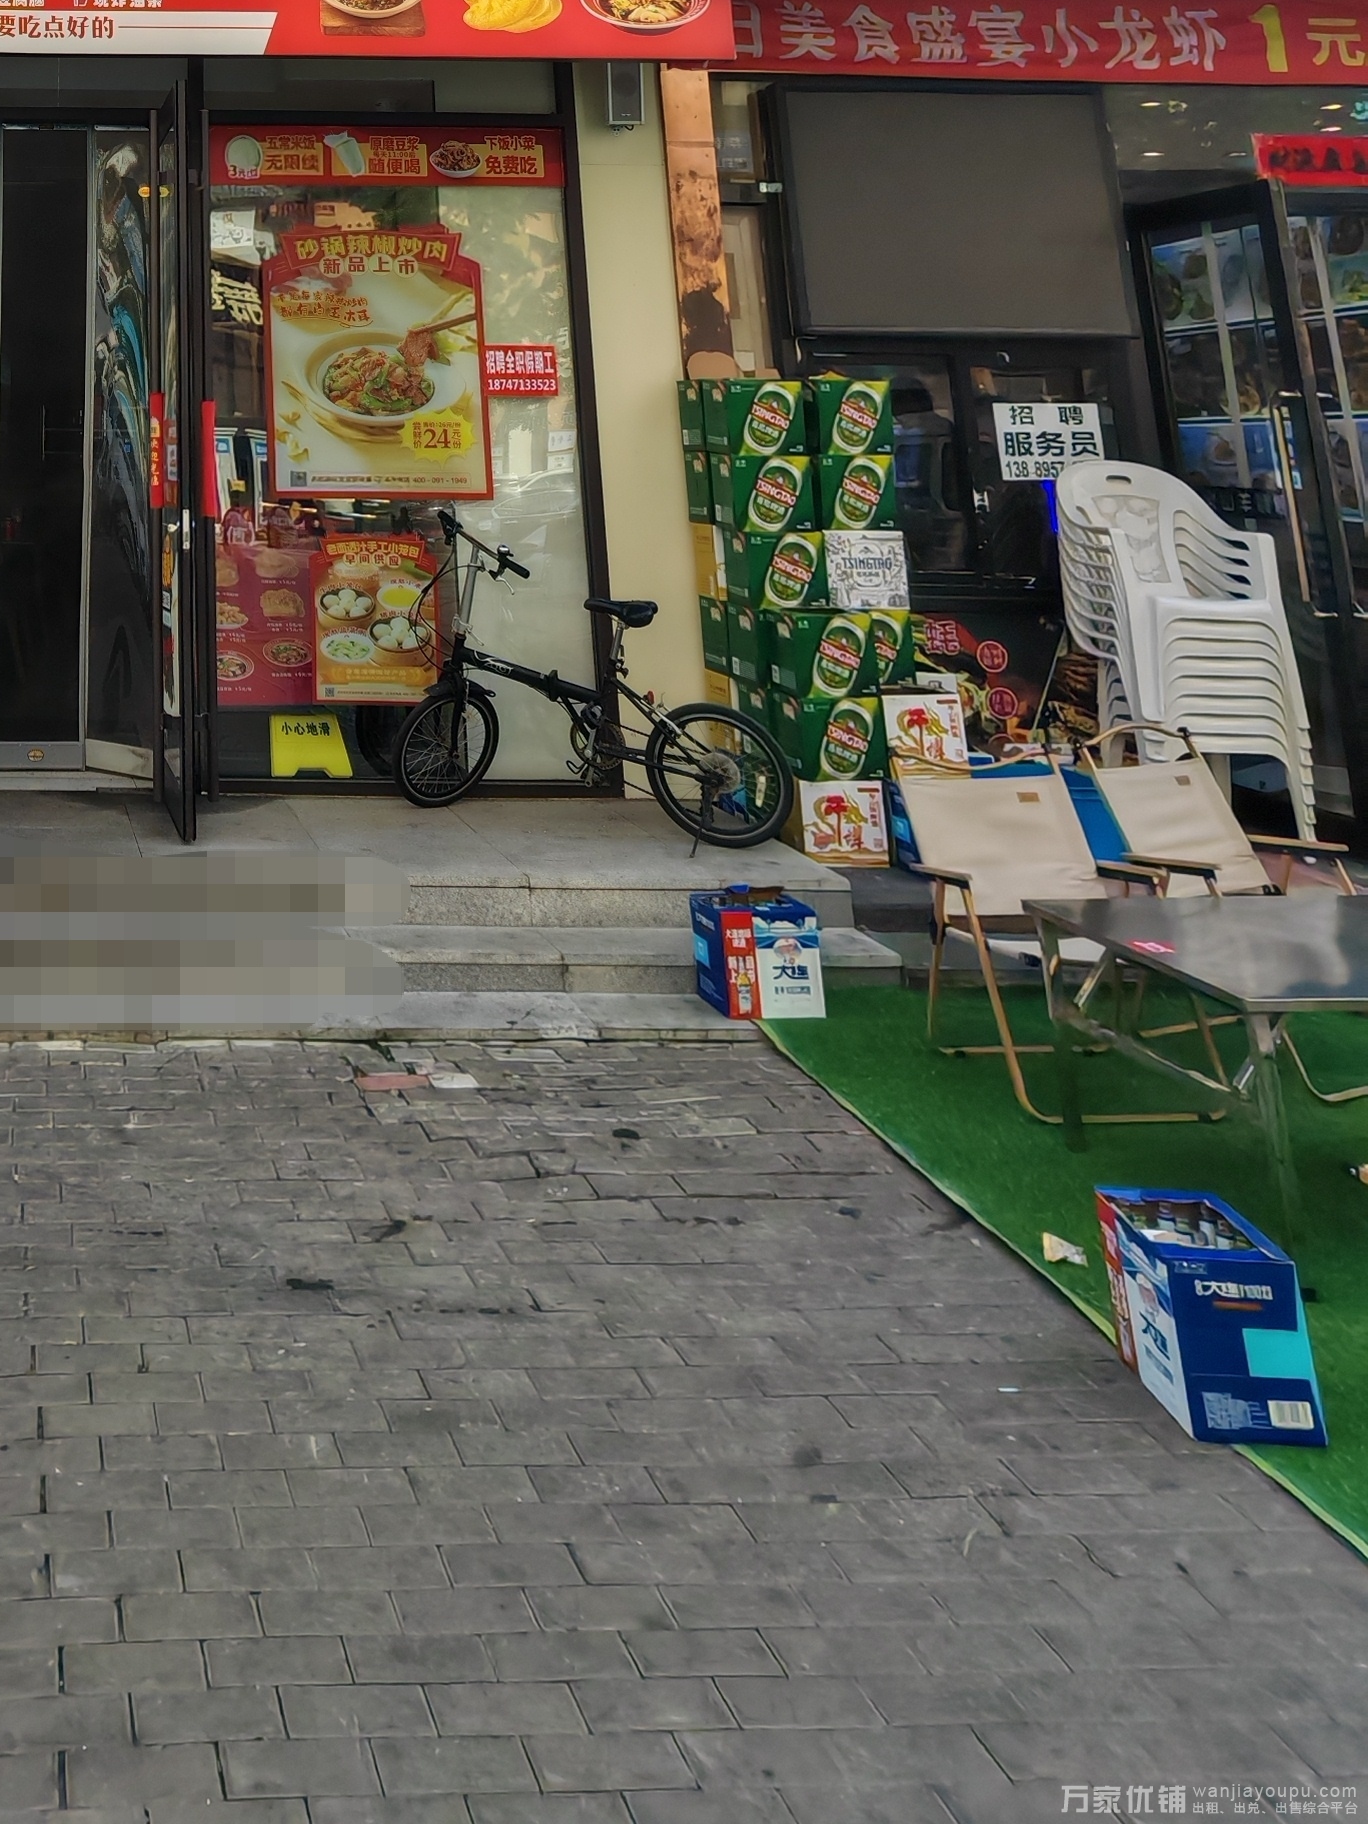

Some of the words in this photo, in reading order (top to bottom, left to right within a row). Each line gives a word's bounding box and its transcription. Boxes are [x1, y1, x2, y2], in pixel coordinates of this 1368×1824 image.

[266, 135, 316, 151] 五常米饭
[369, 136, 420, 151] 原磨豆浆
[484, 136, 537, 151] 下饭小菜
[264, 153, 321, 173] 无限续
[368, 158, 421, 175] 随便喝
[484, 154, 538, 176] 免费吃
[293, 233, 449, 263] 砂锅辣椒炒肉
[321, 256, 417, 276] 新品上市
[485, 349, 555, 375] 招聘全职假期工
[487, 378, 557, 391] 18747133523
[423, 428, 453, 450] 24
[1003, 430, 1101, 457] 服务员
[1005, 461, 1030, 479] 138
[343, 554, 401, 567] 早间供应
[841, 557, 893, 571] TSINGTAO
[281, 721, 331, 737] 小心地滑
